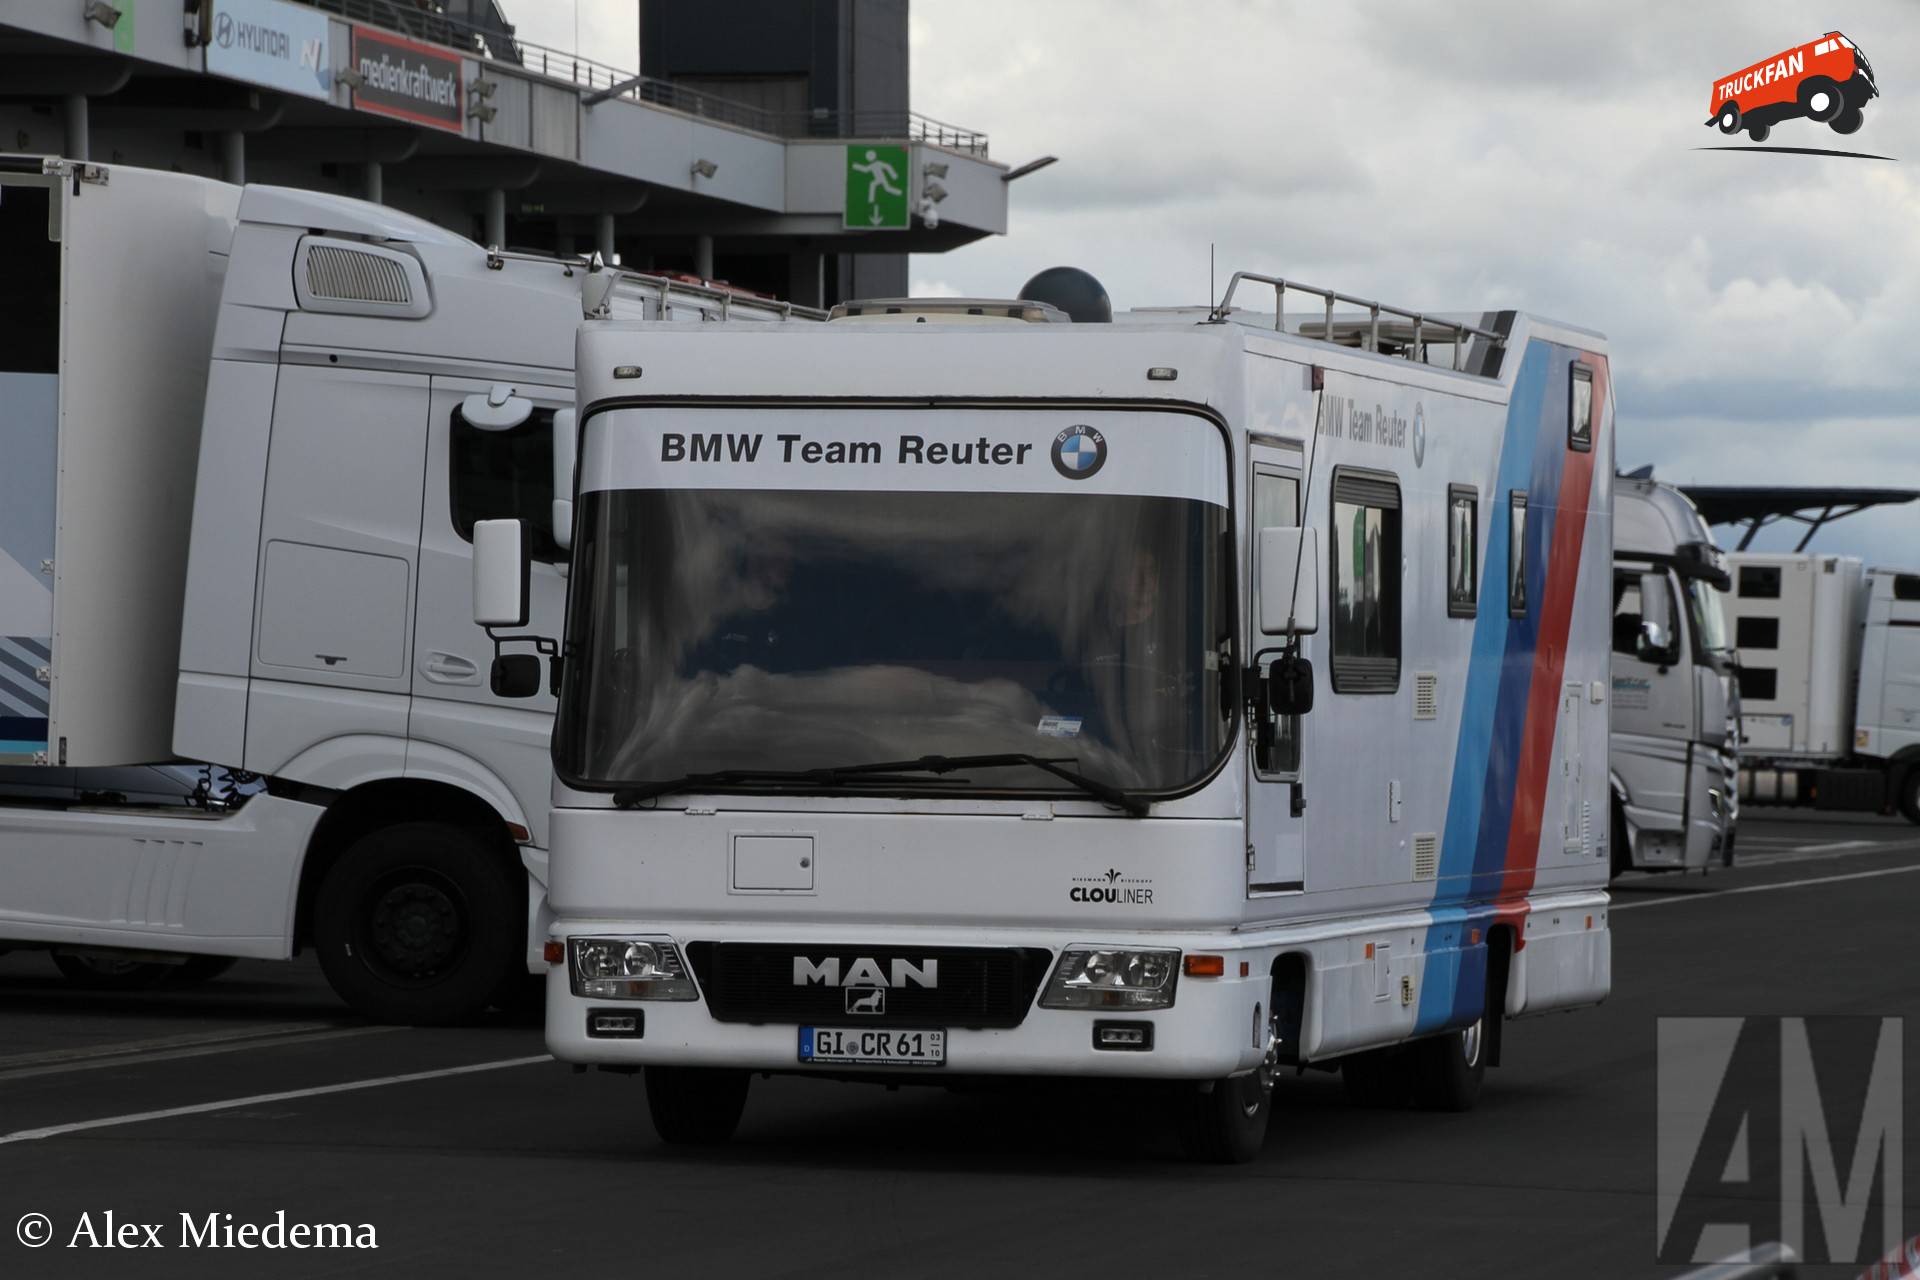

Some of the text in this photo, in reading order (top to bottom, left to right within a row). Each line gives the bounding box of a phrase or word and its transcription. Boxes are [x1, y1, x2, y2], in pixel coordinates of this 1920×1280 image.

[237, 21, 290, 60] HYUNDAI
[360, 54, 456, 107] medienkraftwerk
[1348, 399, 1373, 443] Team
[1375, 404, 1407, 449] Reuter
[661, 433, 1032, 465] BMW Team Reuter
[1069, 887, 1153, 904] CLOULINER
[793, 956, 938, 988] MAN
